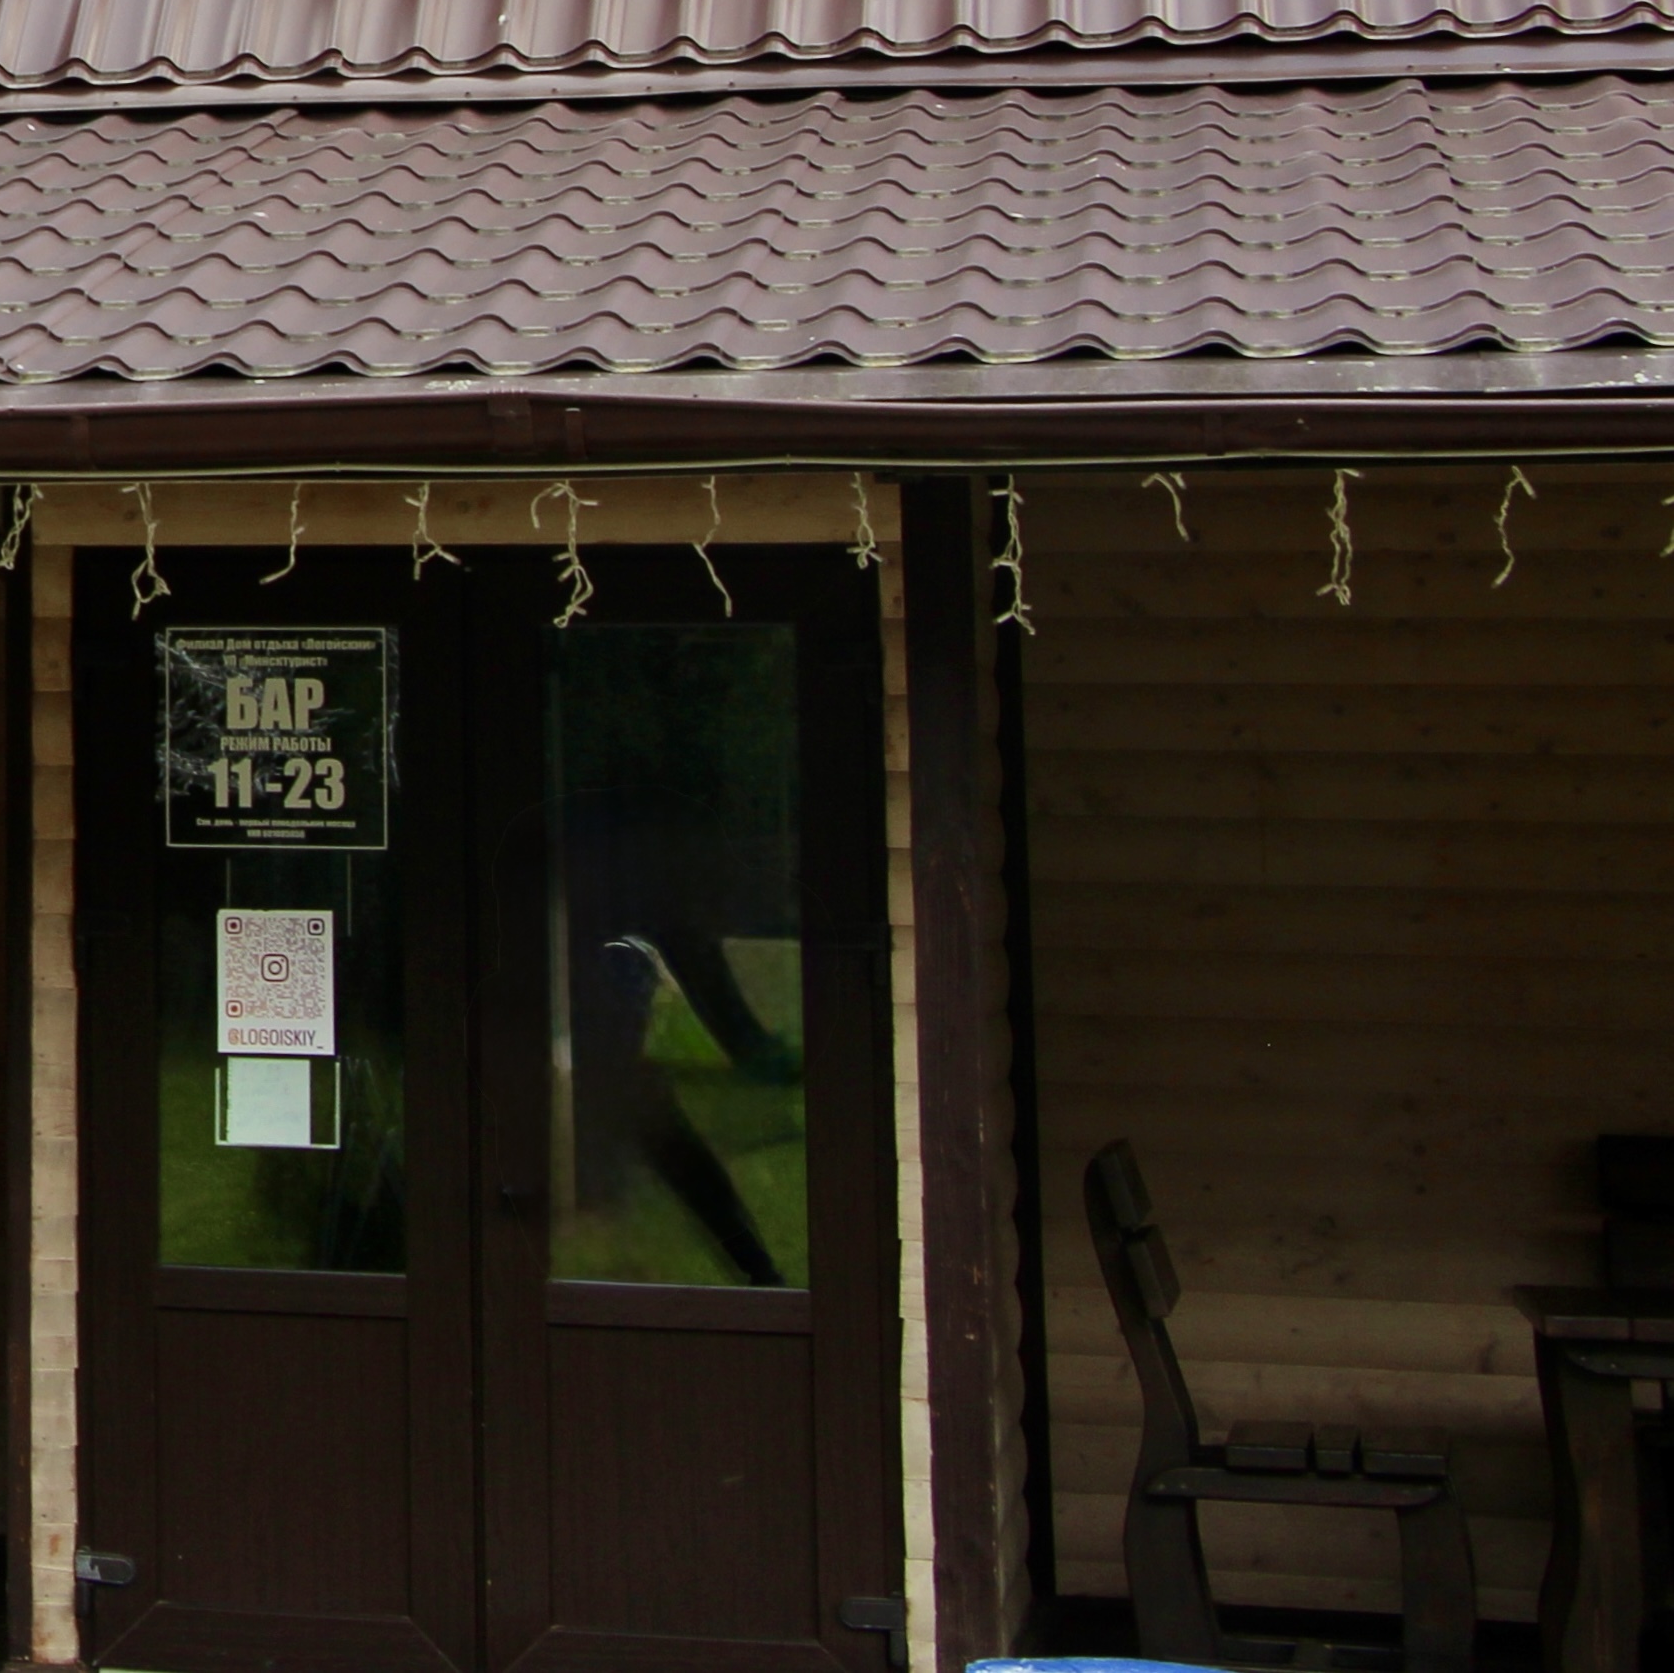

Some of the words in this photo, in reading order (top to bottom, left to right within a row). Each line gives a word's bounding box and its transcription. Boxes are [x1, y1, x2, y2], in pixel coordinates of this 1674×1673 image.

[225, 677, 325, 730] БАР
[220, 736, 270, 752] РЕЖИМ
[273, 736, 332, 752] РАБОТЫ
[227, 1028, 324, 1050] @LOGOISKIY_
